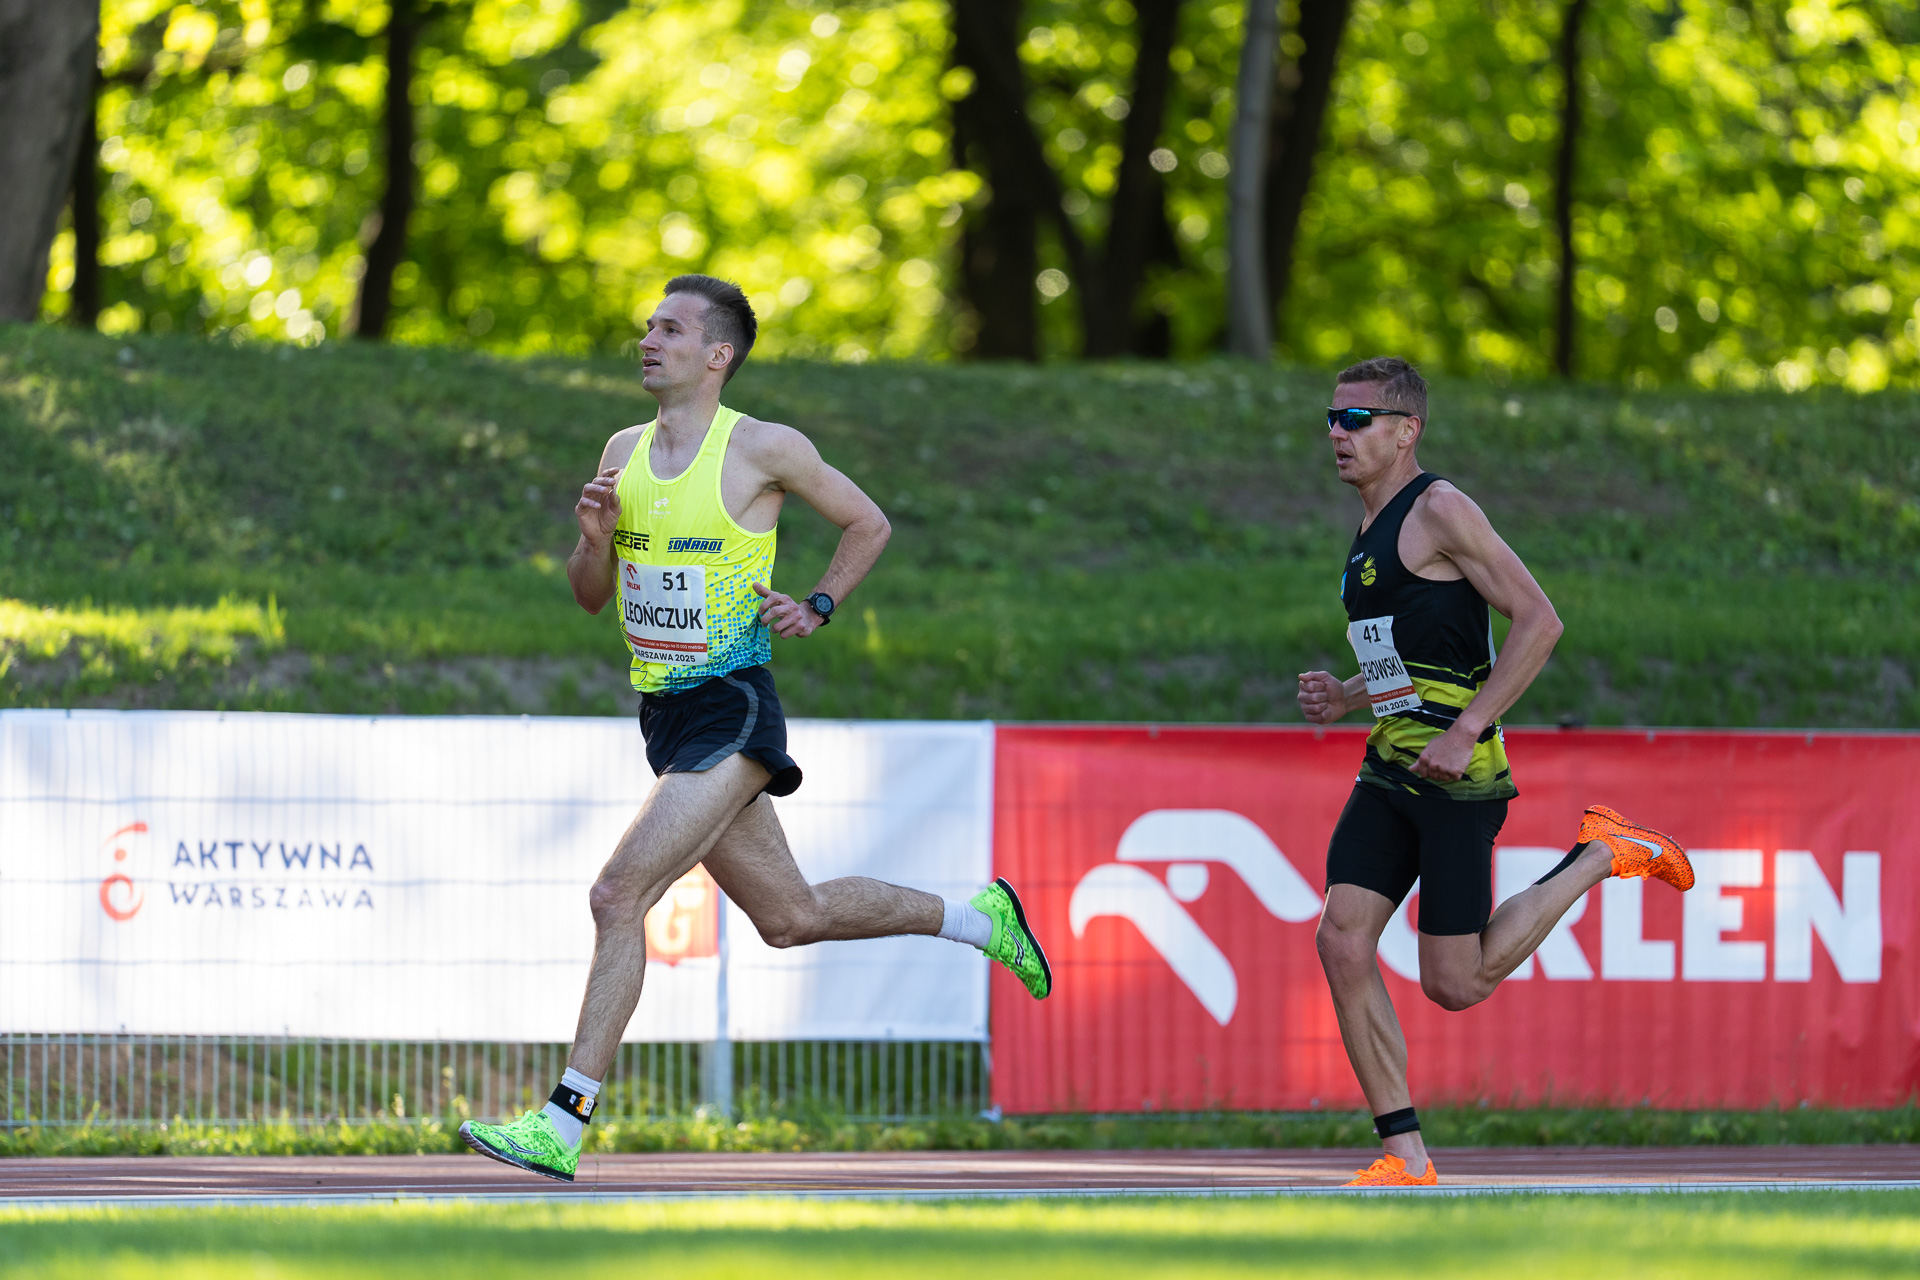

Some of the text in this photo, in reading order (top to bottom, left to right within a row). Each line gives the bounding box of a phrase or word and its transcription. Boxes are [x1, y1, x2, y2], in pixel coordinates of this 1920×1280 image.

[668, 538, 723, 552] SONAROL
[626, 580, 641, 591] ORLEN
[662, 571, 688, 591] 51
[624, 598, 704, 630] LEOŃCZUK
[1363, 624, 1381, 643] 41
[634, 647, 696, 662] WARSZAWA 2025
[1360, 656, 1404, 682] CHOWSKI
[1390, 699, 1409, 710] 2025
[173, 840, 373, 870] AKTYWNA
[169, 882, 373, 908] WARSZAWA
